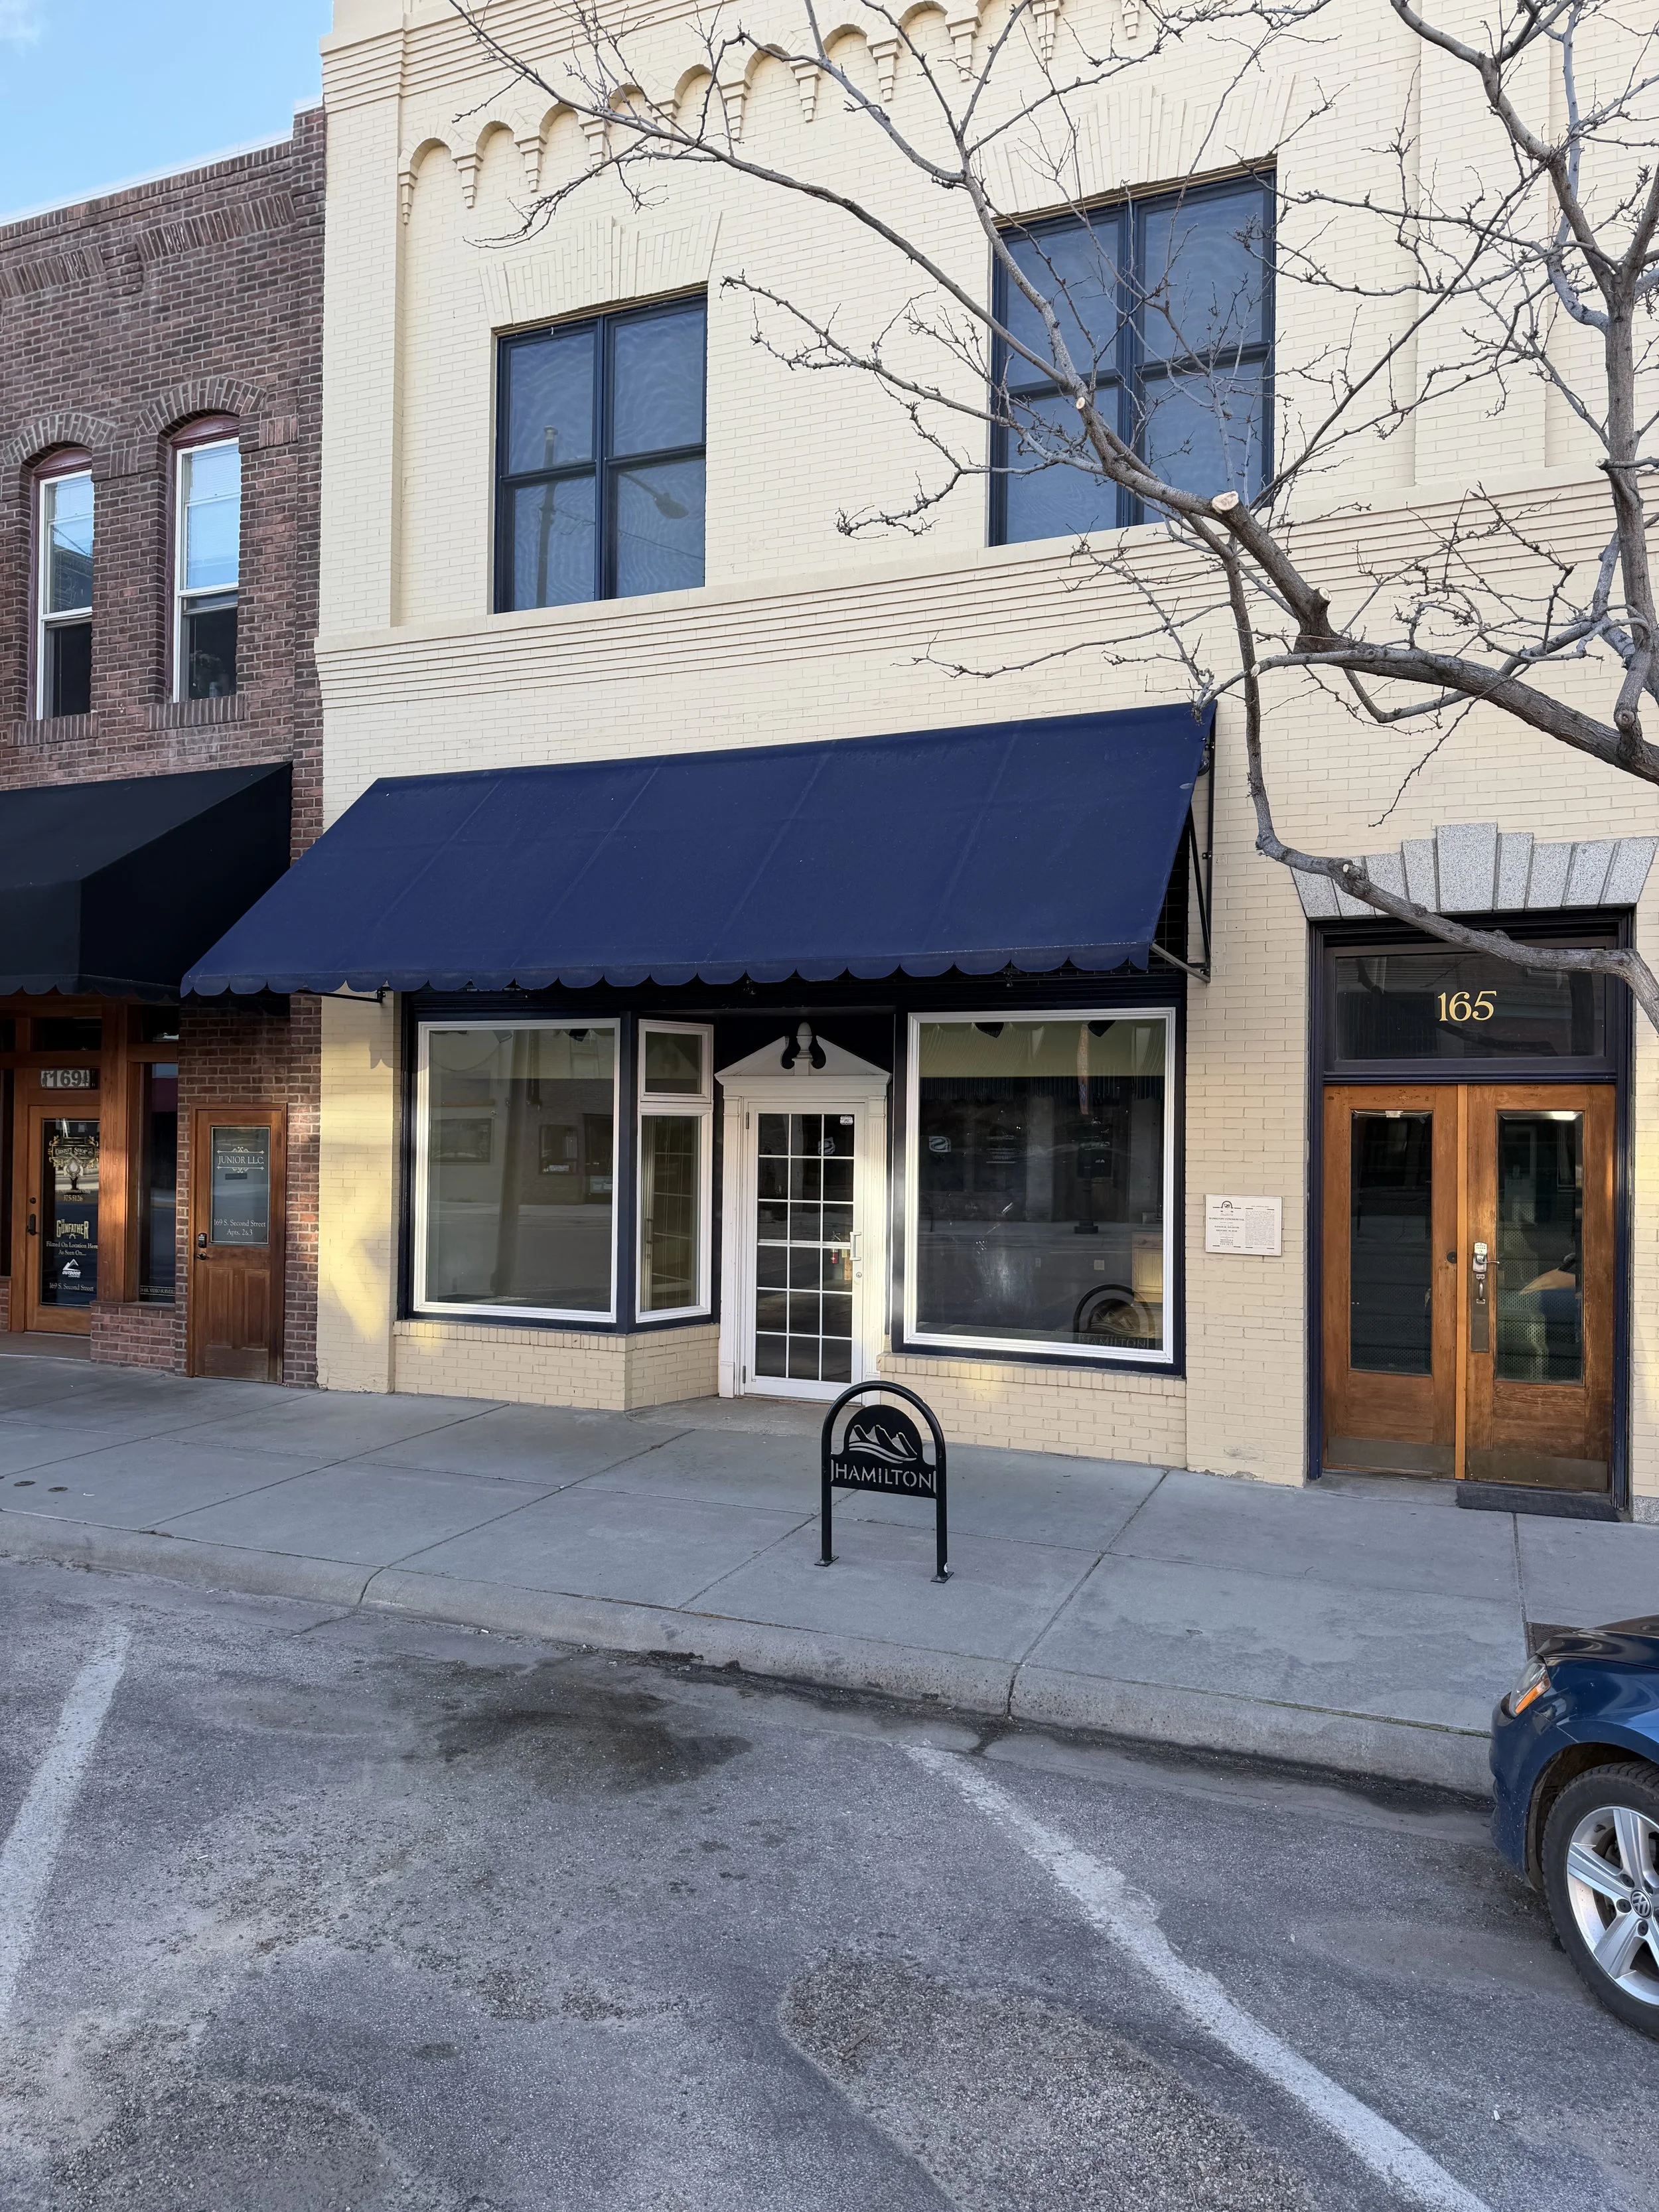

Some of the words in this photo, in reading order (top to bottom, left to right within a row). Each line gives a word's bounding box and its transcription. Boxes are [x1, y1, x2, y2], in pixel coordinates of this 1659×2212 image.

[1437, 991, 1496, 1021] 165
[50, 1070, 82, 1087] 169
[218, 1155, 246, 1165] JUNIOR
[56, 1220, 89, 1239] GUNFATHER
[835, 1463, 932, 1489] HAMILTON
